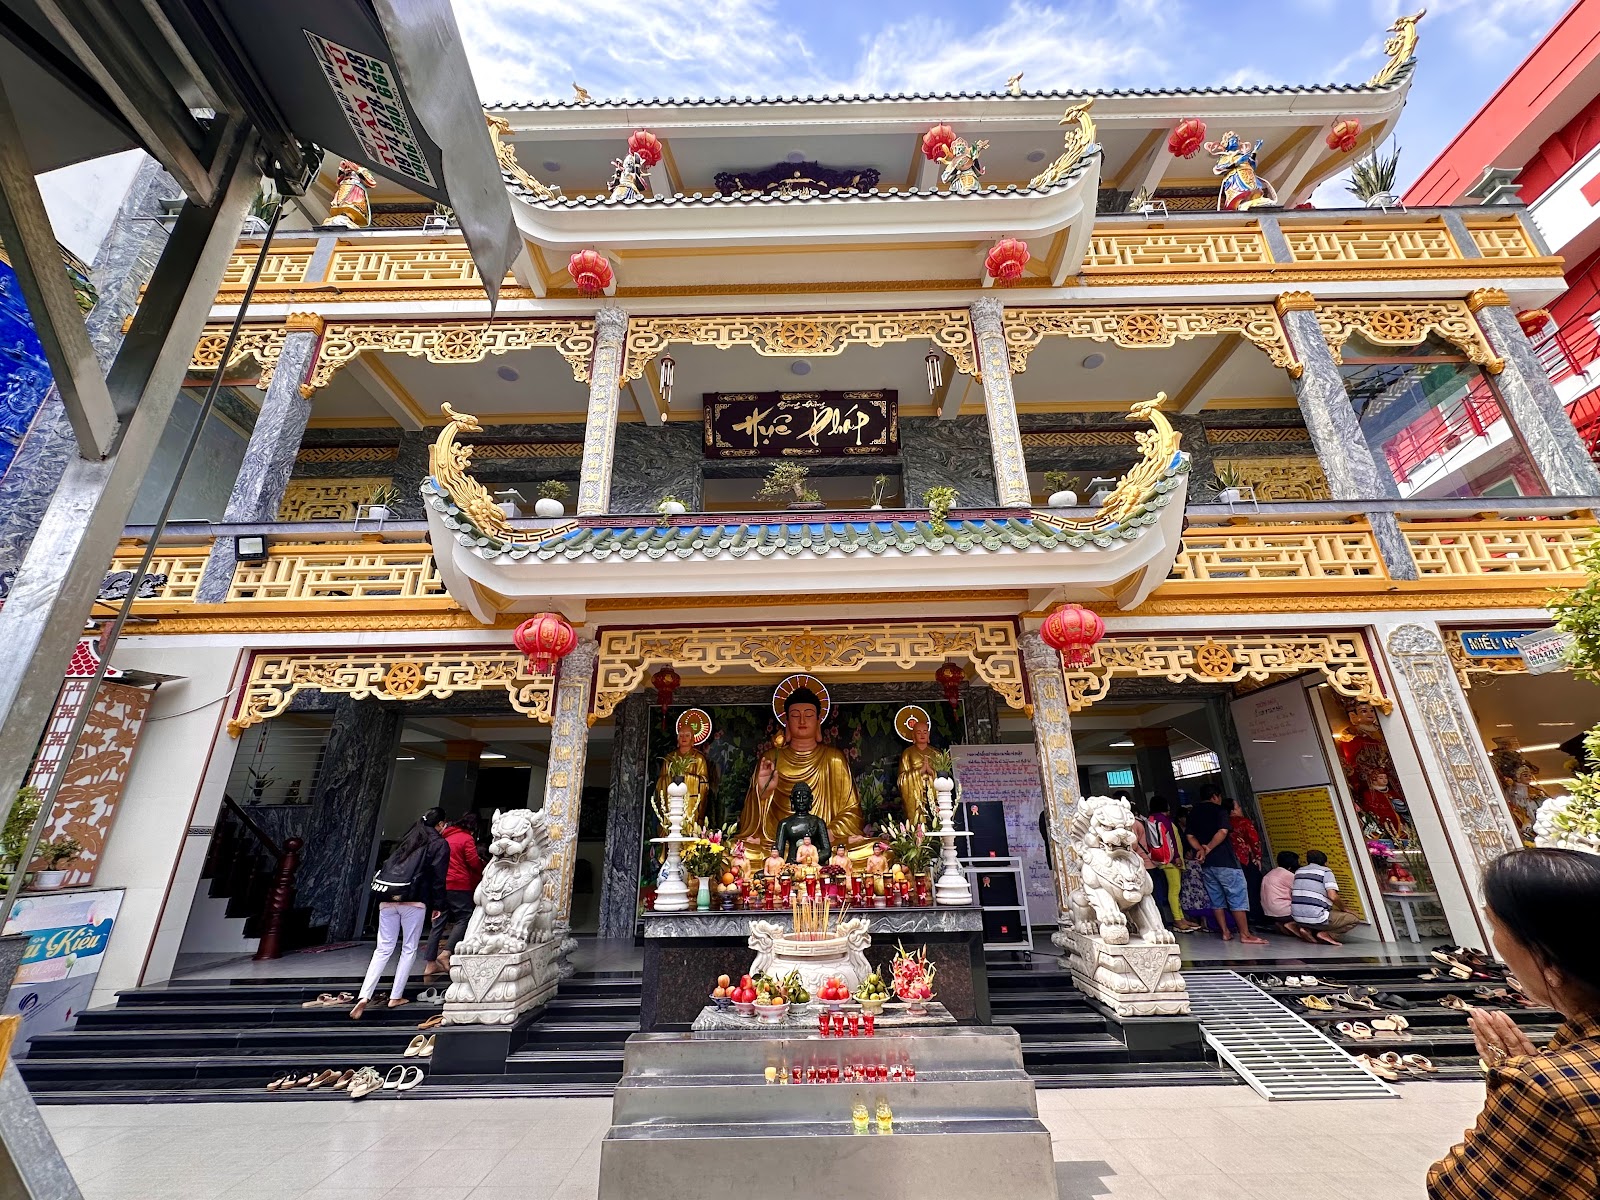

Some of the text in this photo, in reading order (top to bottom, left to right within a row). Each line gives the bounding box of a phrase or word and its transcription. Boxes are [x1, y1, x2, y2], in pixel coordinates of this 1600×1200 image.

[326, 42, 398, 168] TUẤN TÚ
[347, 51, 417, 178] 0974.878.348
[368, 58, 430, 183] 0906.390.665
[796, 403, 870, 447] Pháp
